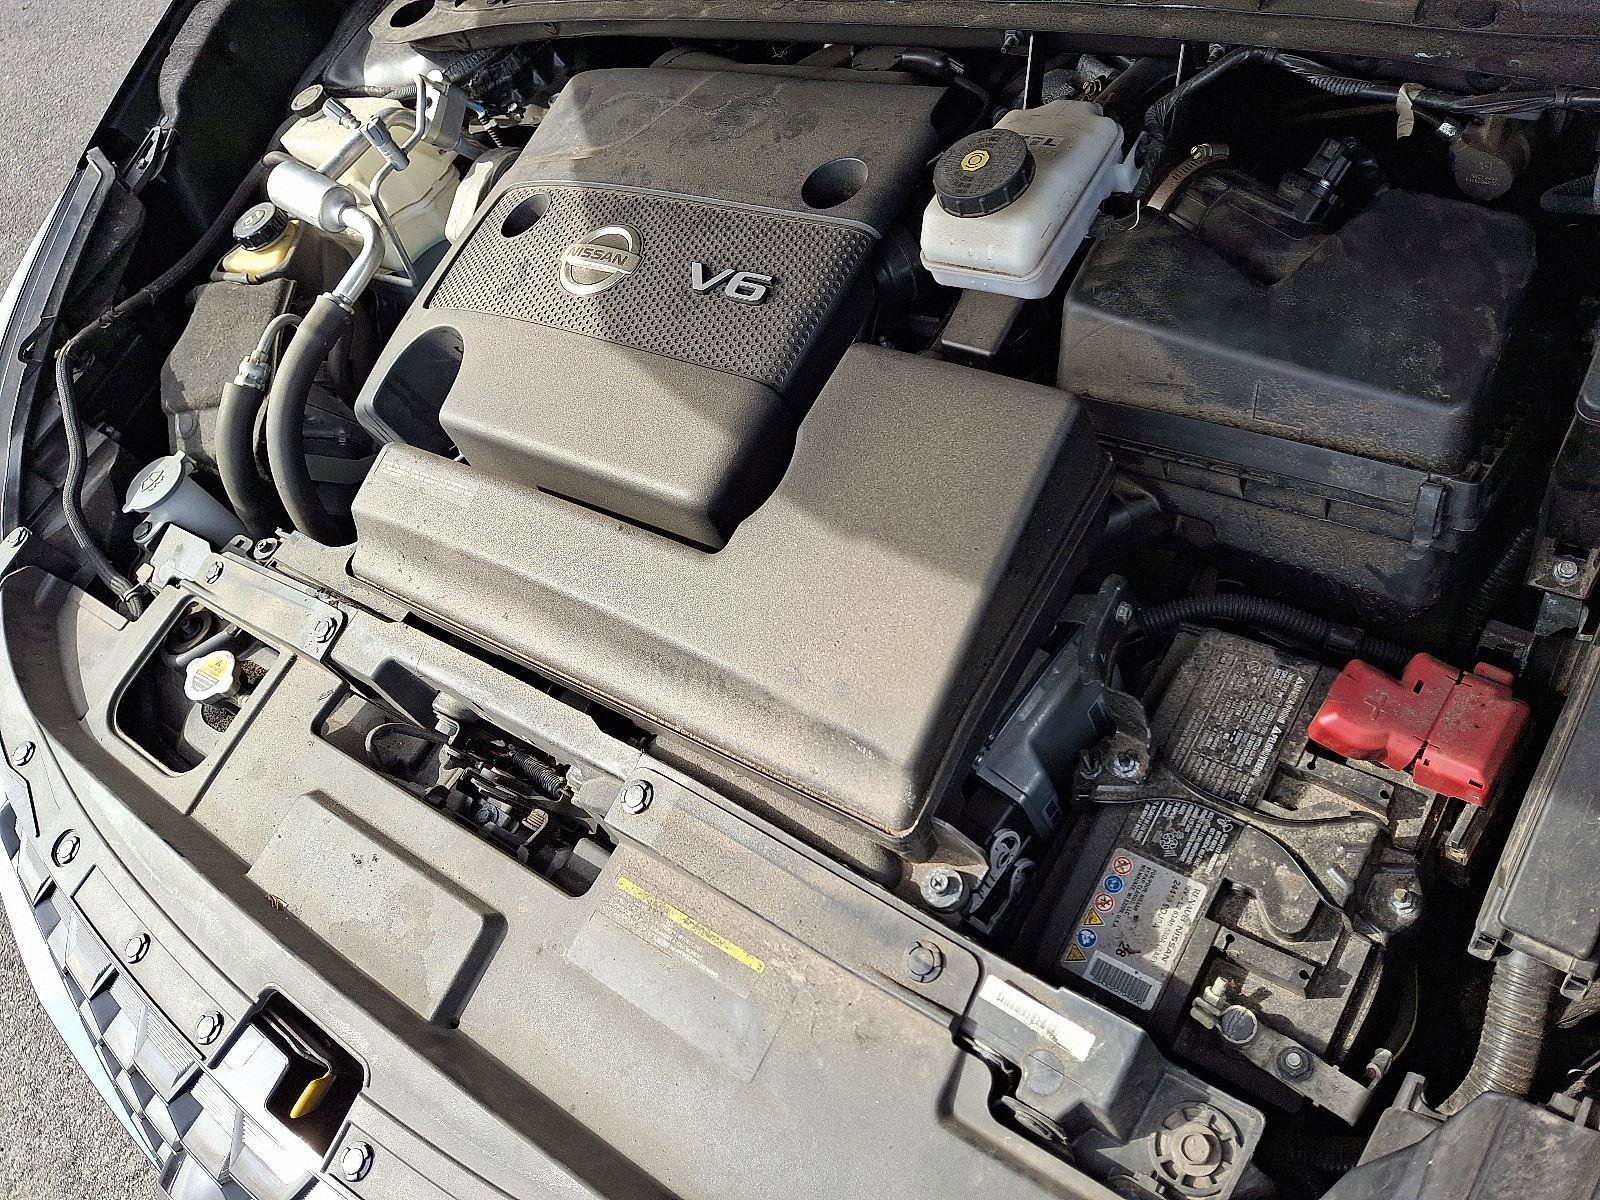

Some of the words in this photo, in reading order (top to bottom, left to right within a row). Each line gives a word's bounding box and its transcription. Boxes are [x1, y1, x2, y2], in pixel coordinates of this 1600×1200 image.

[567, 246, 629, 266] NISSAN
[691, 261, 774, 306] V6
[1114, 940, 1130, 958] 28
[1160, 924, 1183, 962] NISSAN
